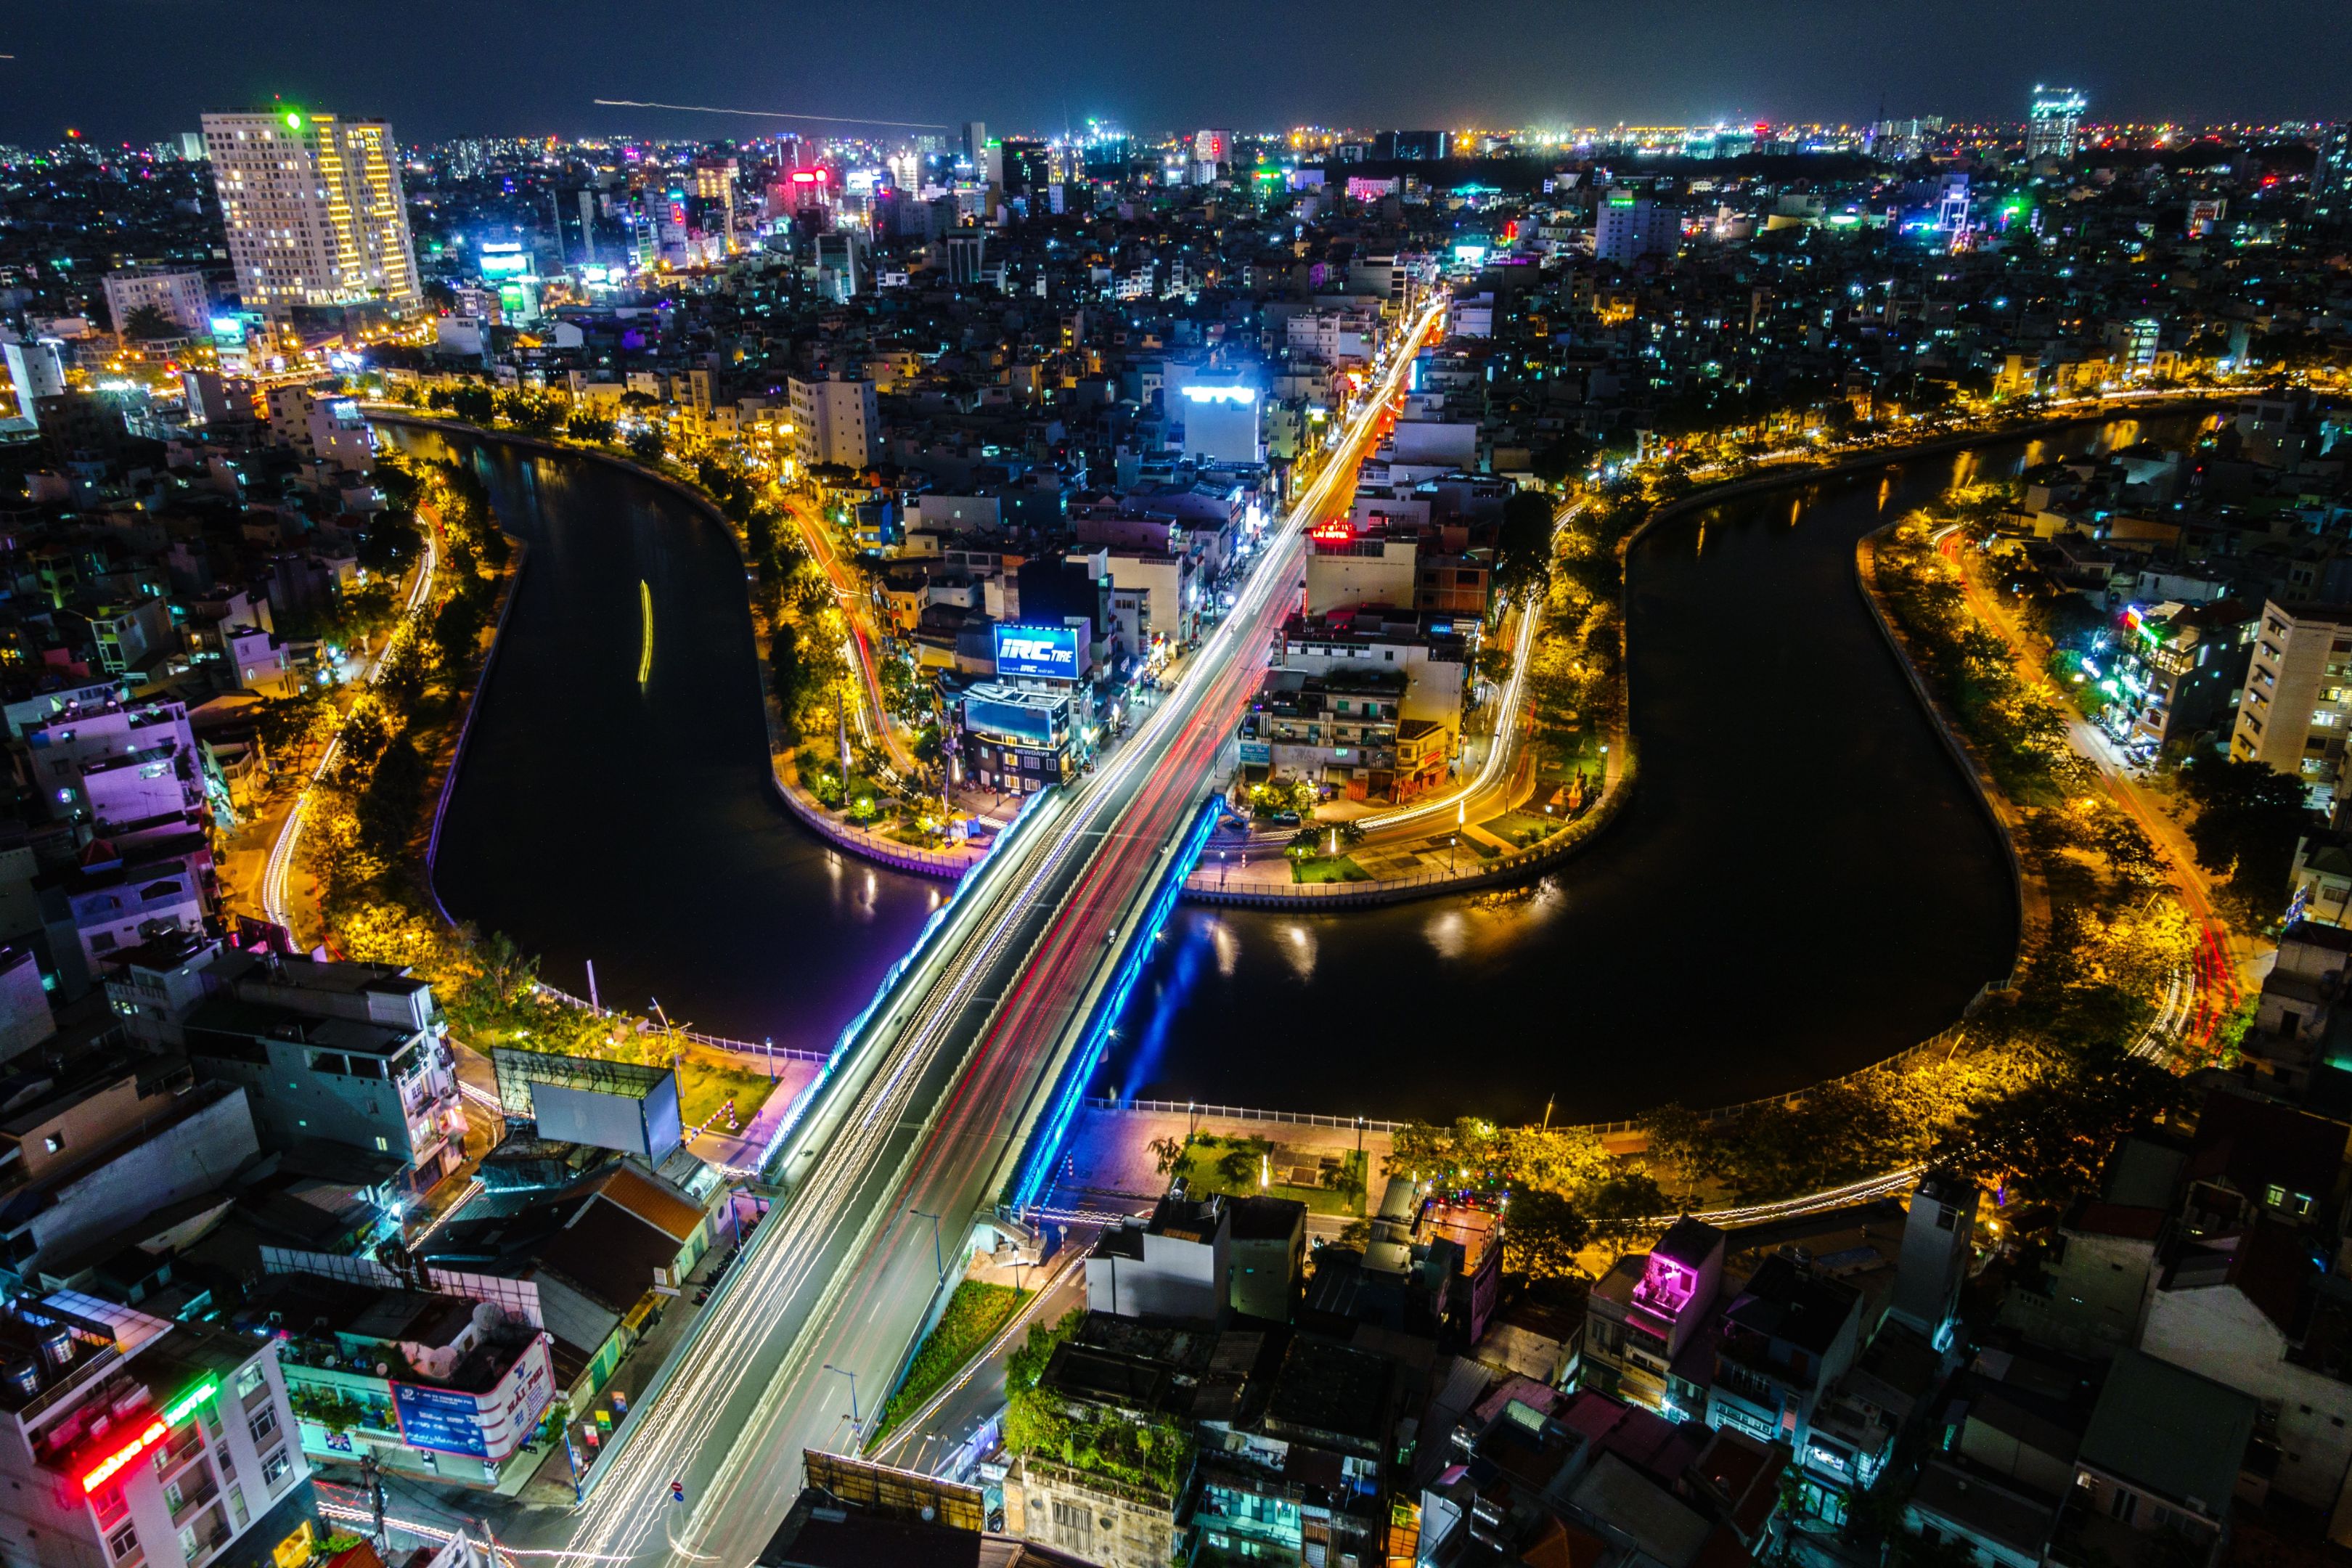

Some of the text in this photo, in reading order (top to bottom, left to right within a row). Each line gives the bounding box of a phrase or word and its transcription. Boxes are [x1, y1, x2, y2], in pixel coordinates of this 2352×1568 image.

[1000, 638, 1073, 663] IRC TIRE
[1020, 664, 1037, 673] IRC
[166, 1383, 217, 1428] HOTEL
